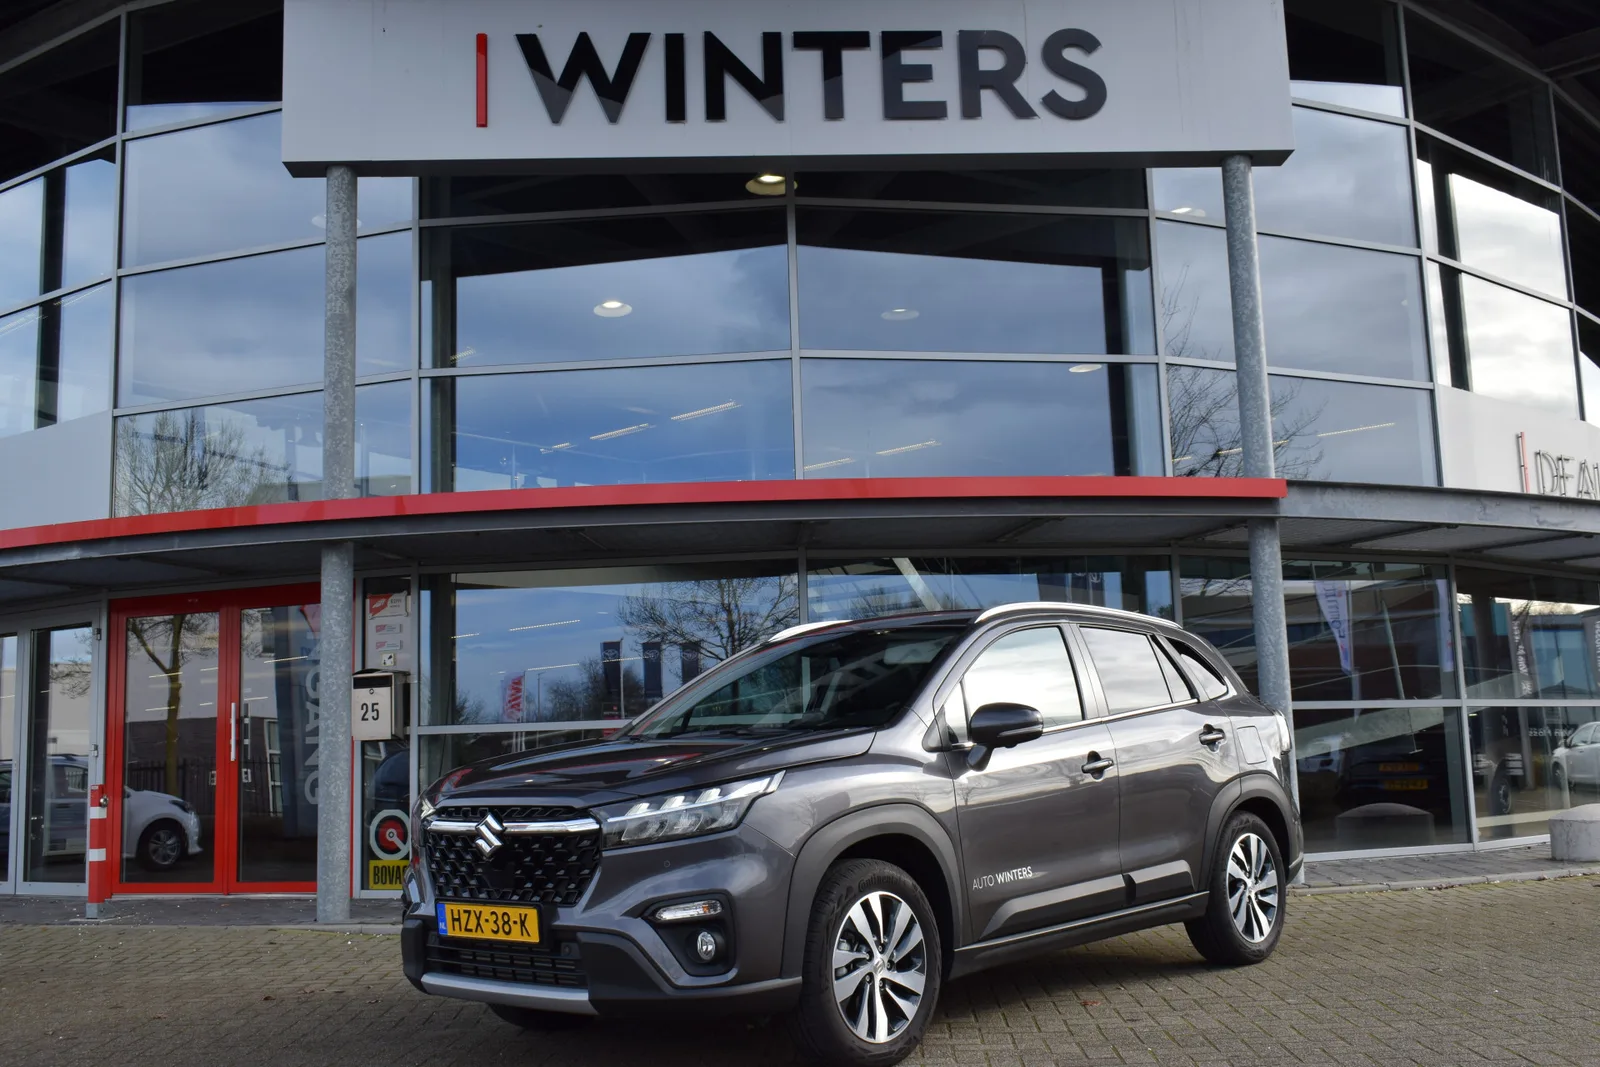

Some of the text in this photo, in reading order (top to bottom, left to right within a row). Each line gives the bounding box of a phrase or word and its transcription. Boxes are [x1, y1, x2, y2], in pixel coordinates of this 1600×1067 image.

[514, 28, 1108, 124] WINTERS
[361, 702, 380, 721] 25
[972, 866, 1033, 890] AUTO WINTERS
[439, 921, 447, 930] NL
[450, 909, 532, 938] HZX-38-K
